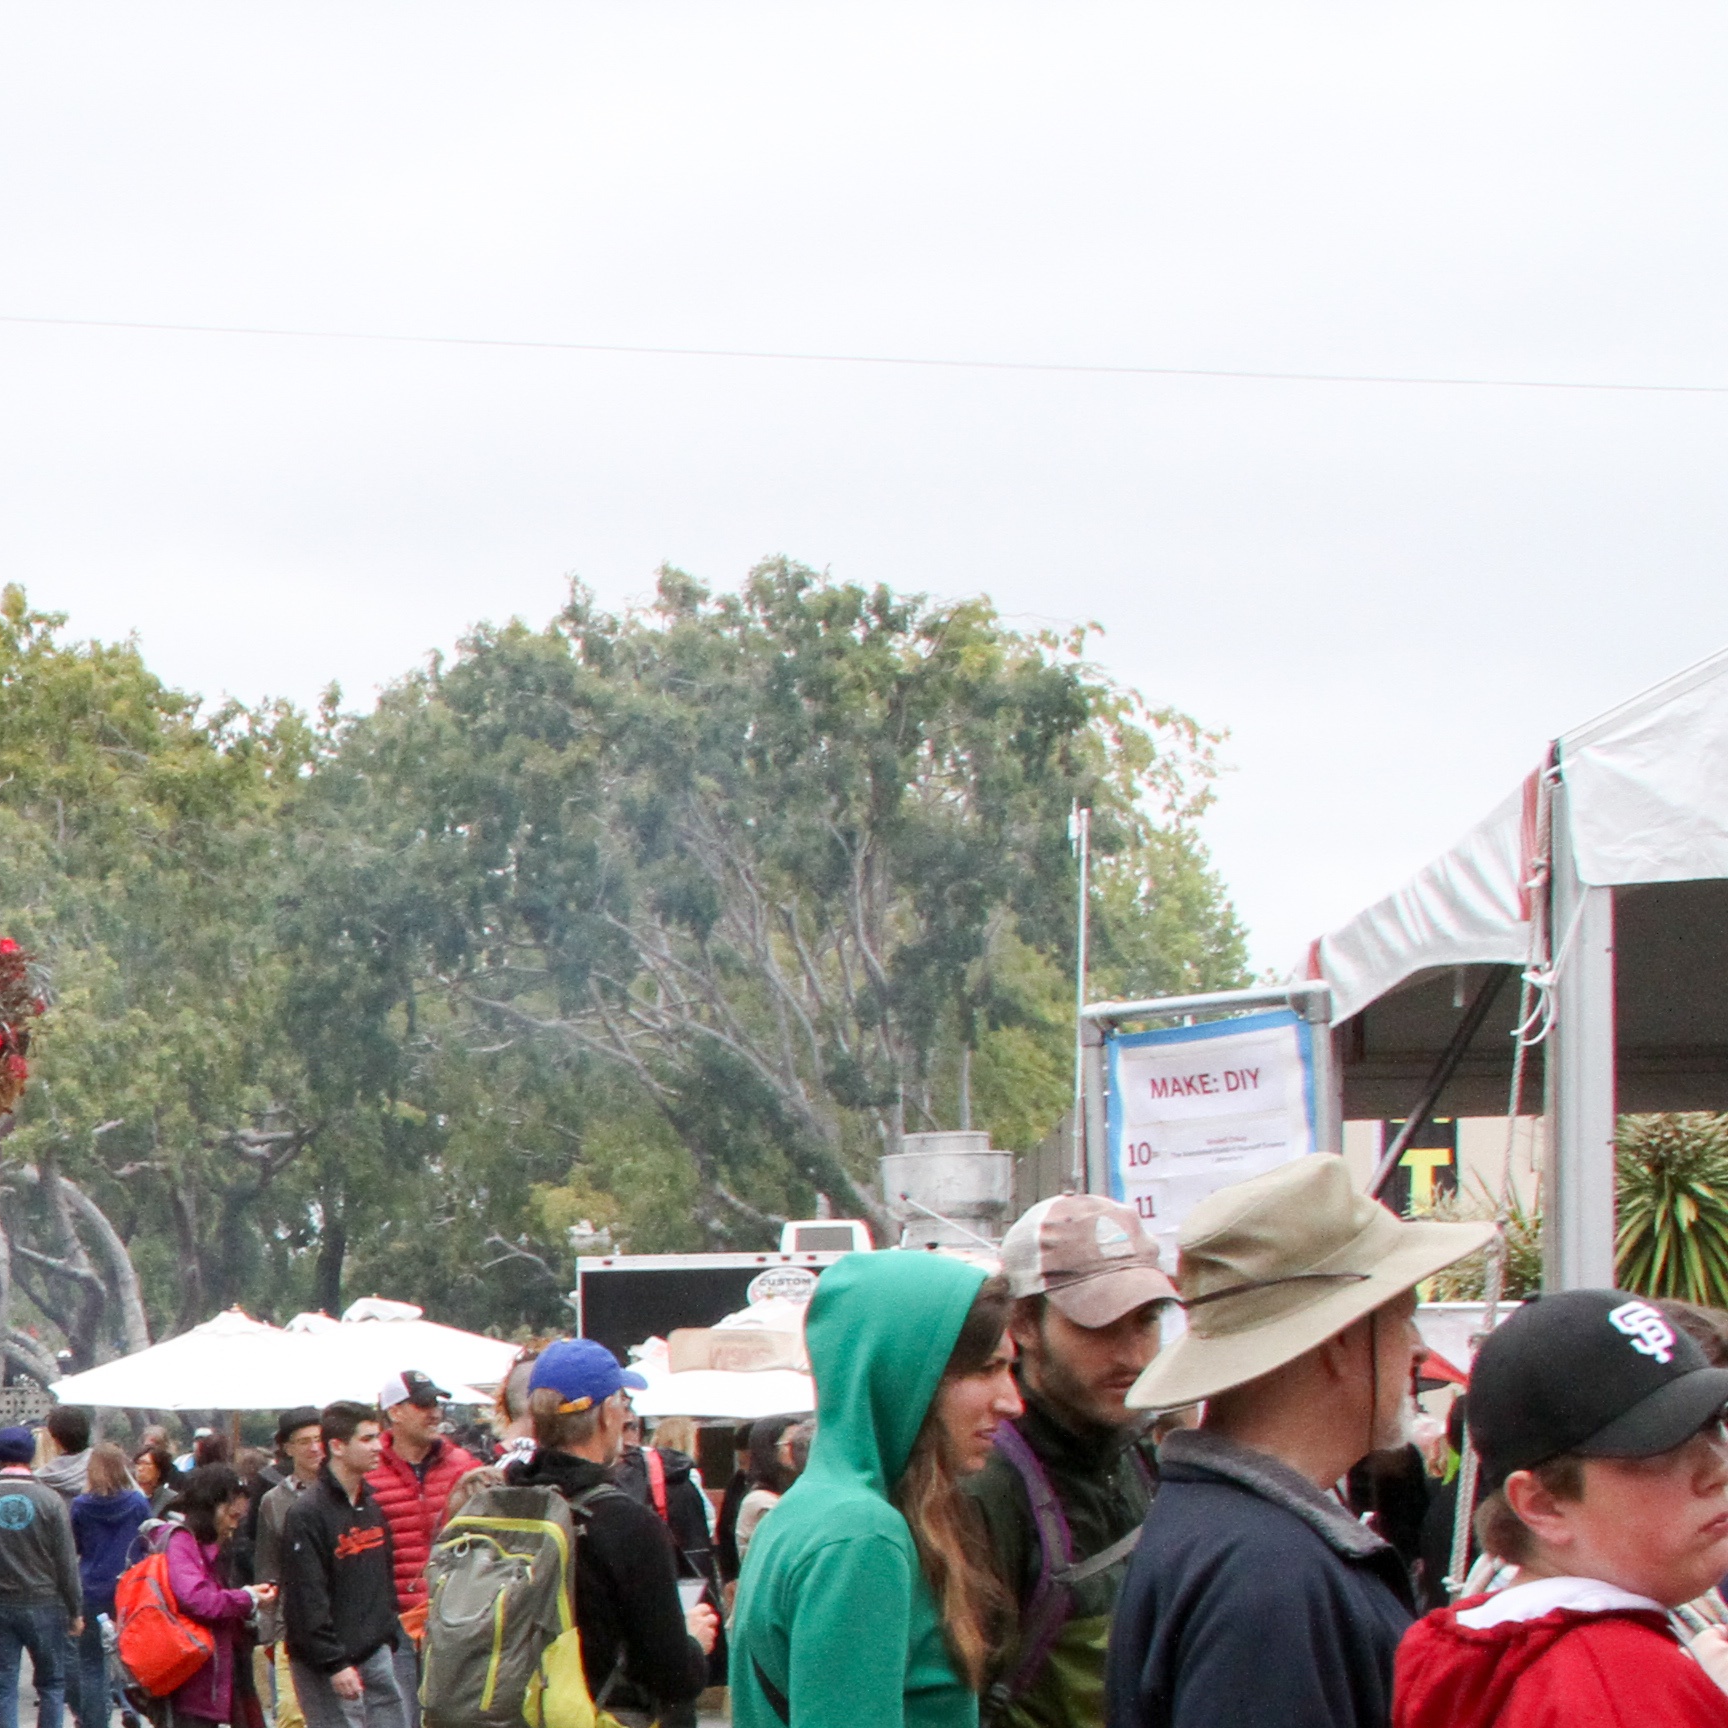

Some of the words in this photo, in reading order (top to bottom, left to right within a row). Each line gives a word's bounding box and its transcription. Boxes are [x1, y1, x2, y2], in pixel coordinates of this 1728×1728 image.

[1150, 1073, 1219, 1099] MAKE:
[1224, 1067, 1260, 1093] DIY
[1128, 1142, 1152, 1167] 10
[1135, 1195, 1156, 1219] 11
